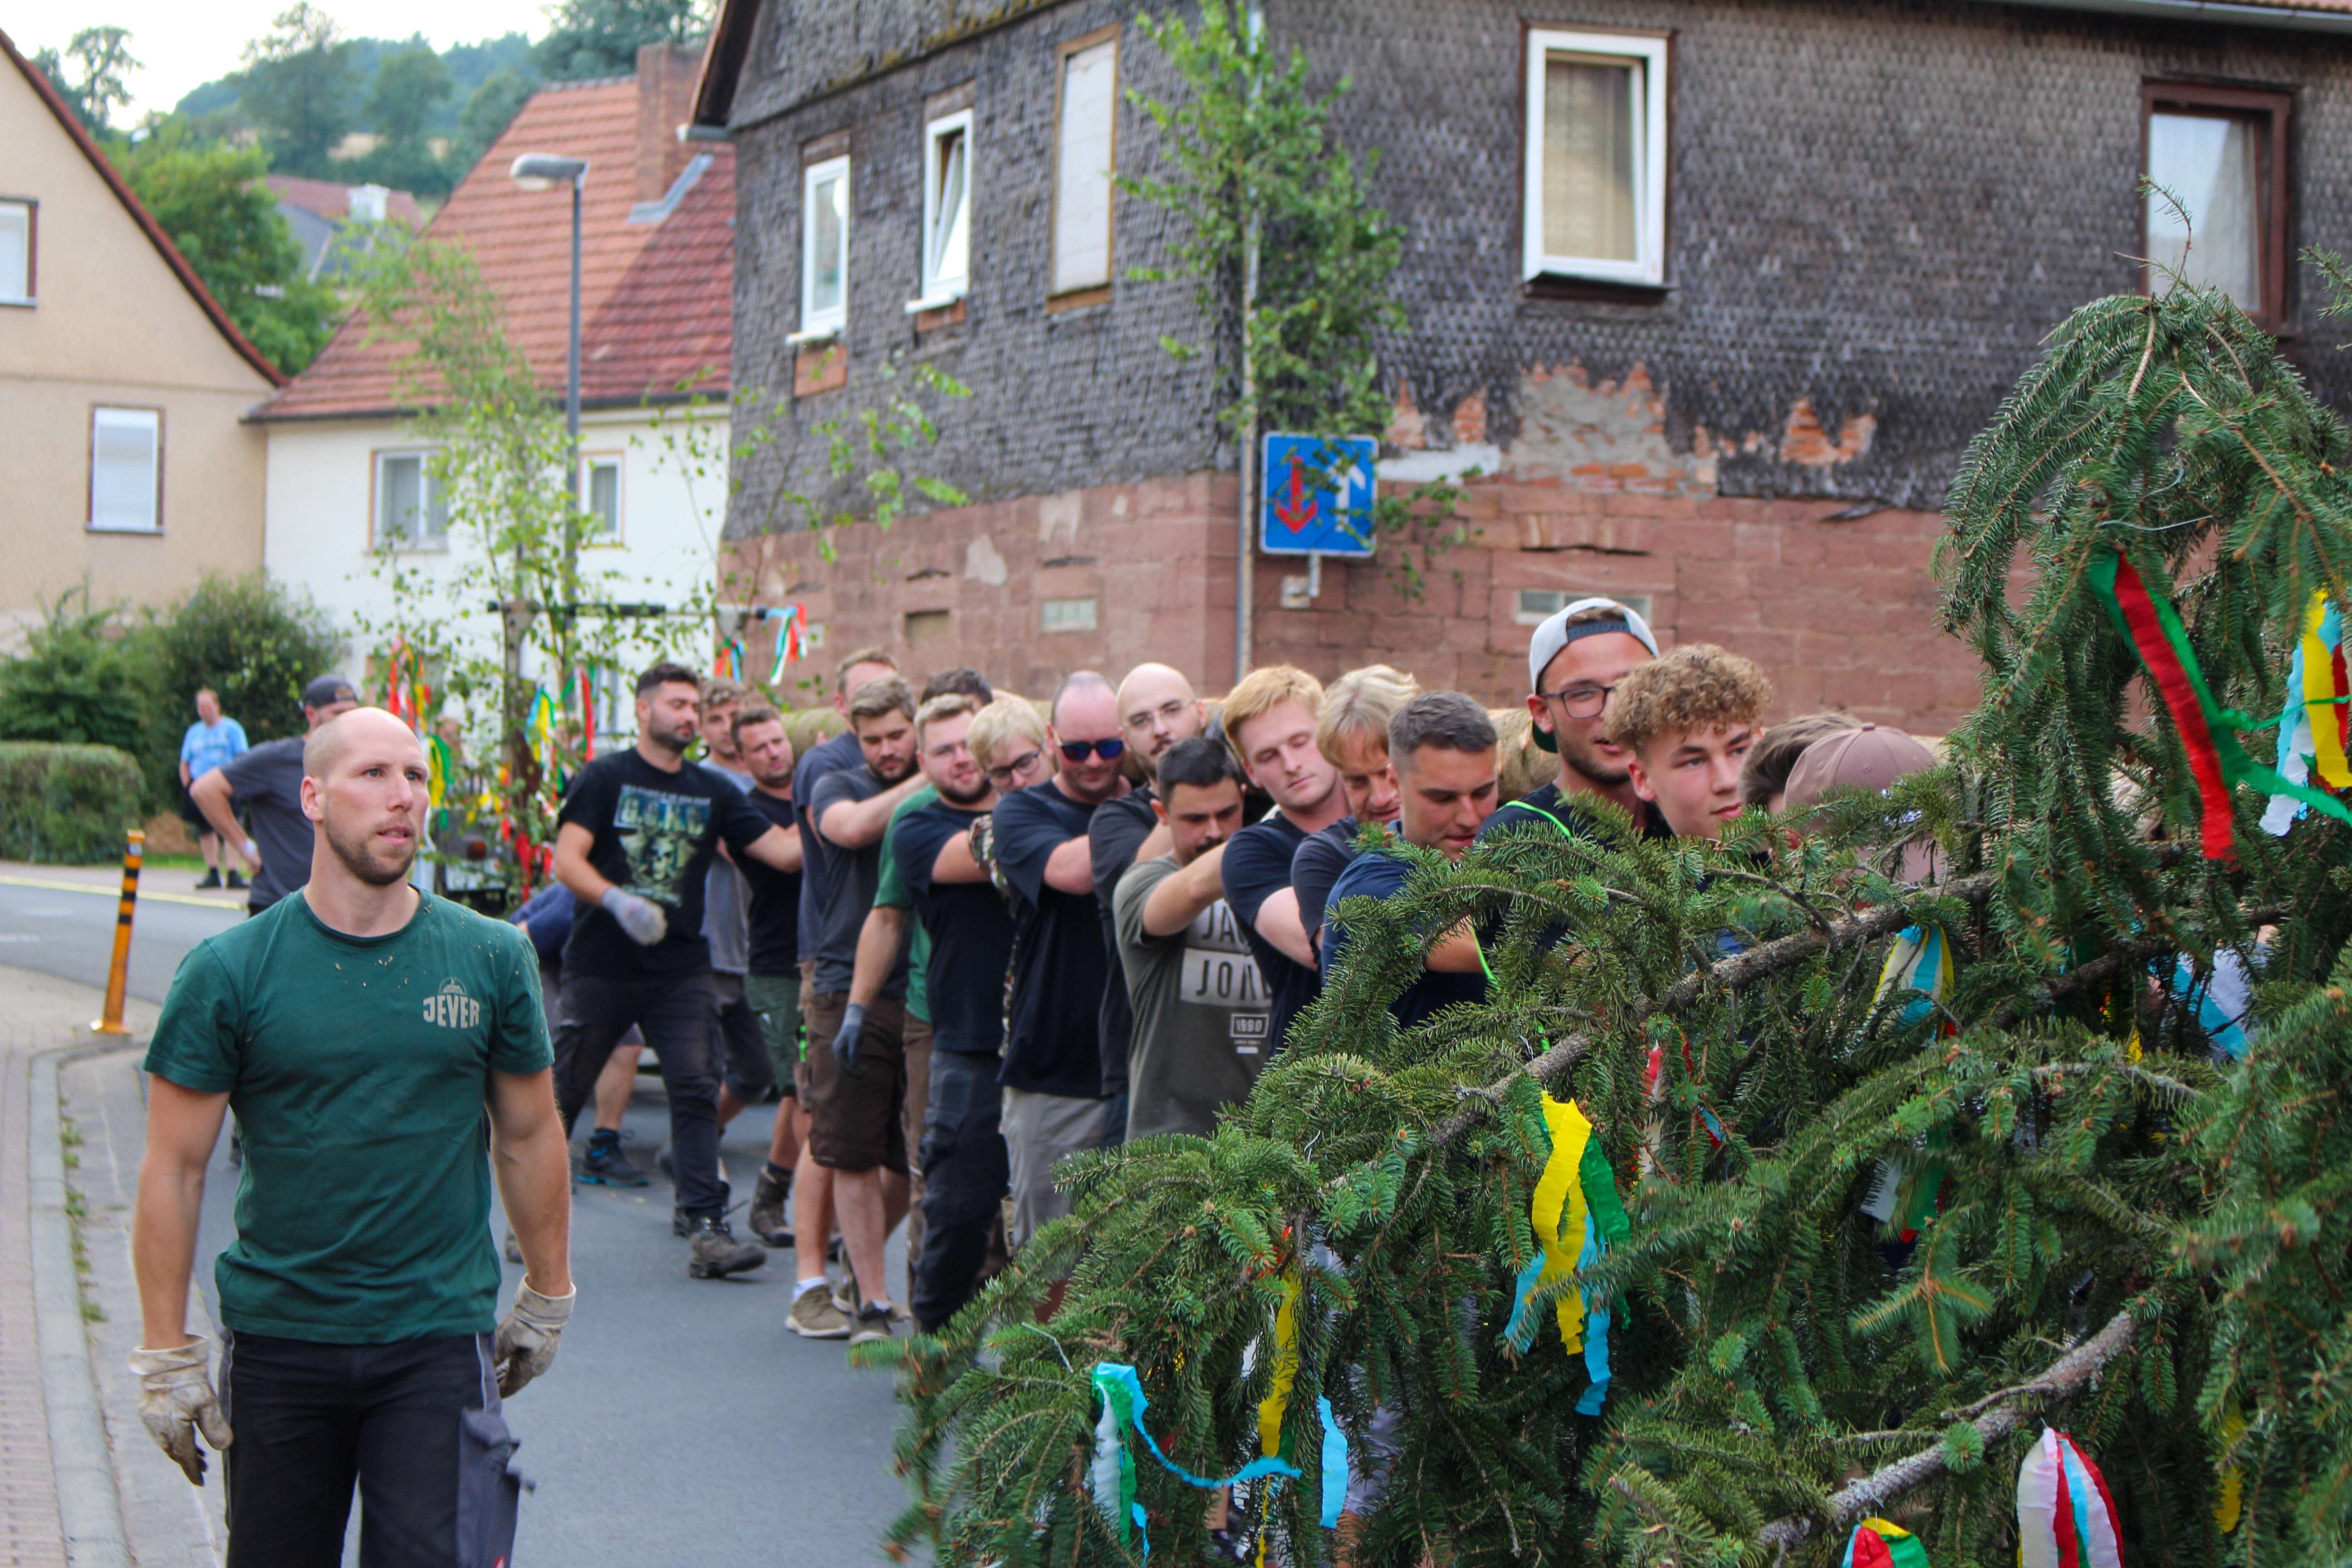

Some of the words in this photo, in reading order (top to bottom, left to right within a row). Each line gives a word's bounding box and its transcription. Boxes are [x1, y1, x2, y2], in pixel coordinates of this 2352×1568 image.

[1202, 904, 1246, 945] JA
[423, 994, 480, 1029] JEVER
[1235, 1018, 1263, 1033] 1990
